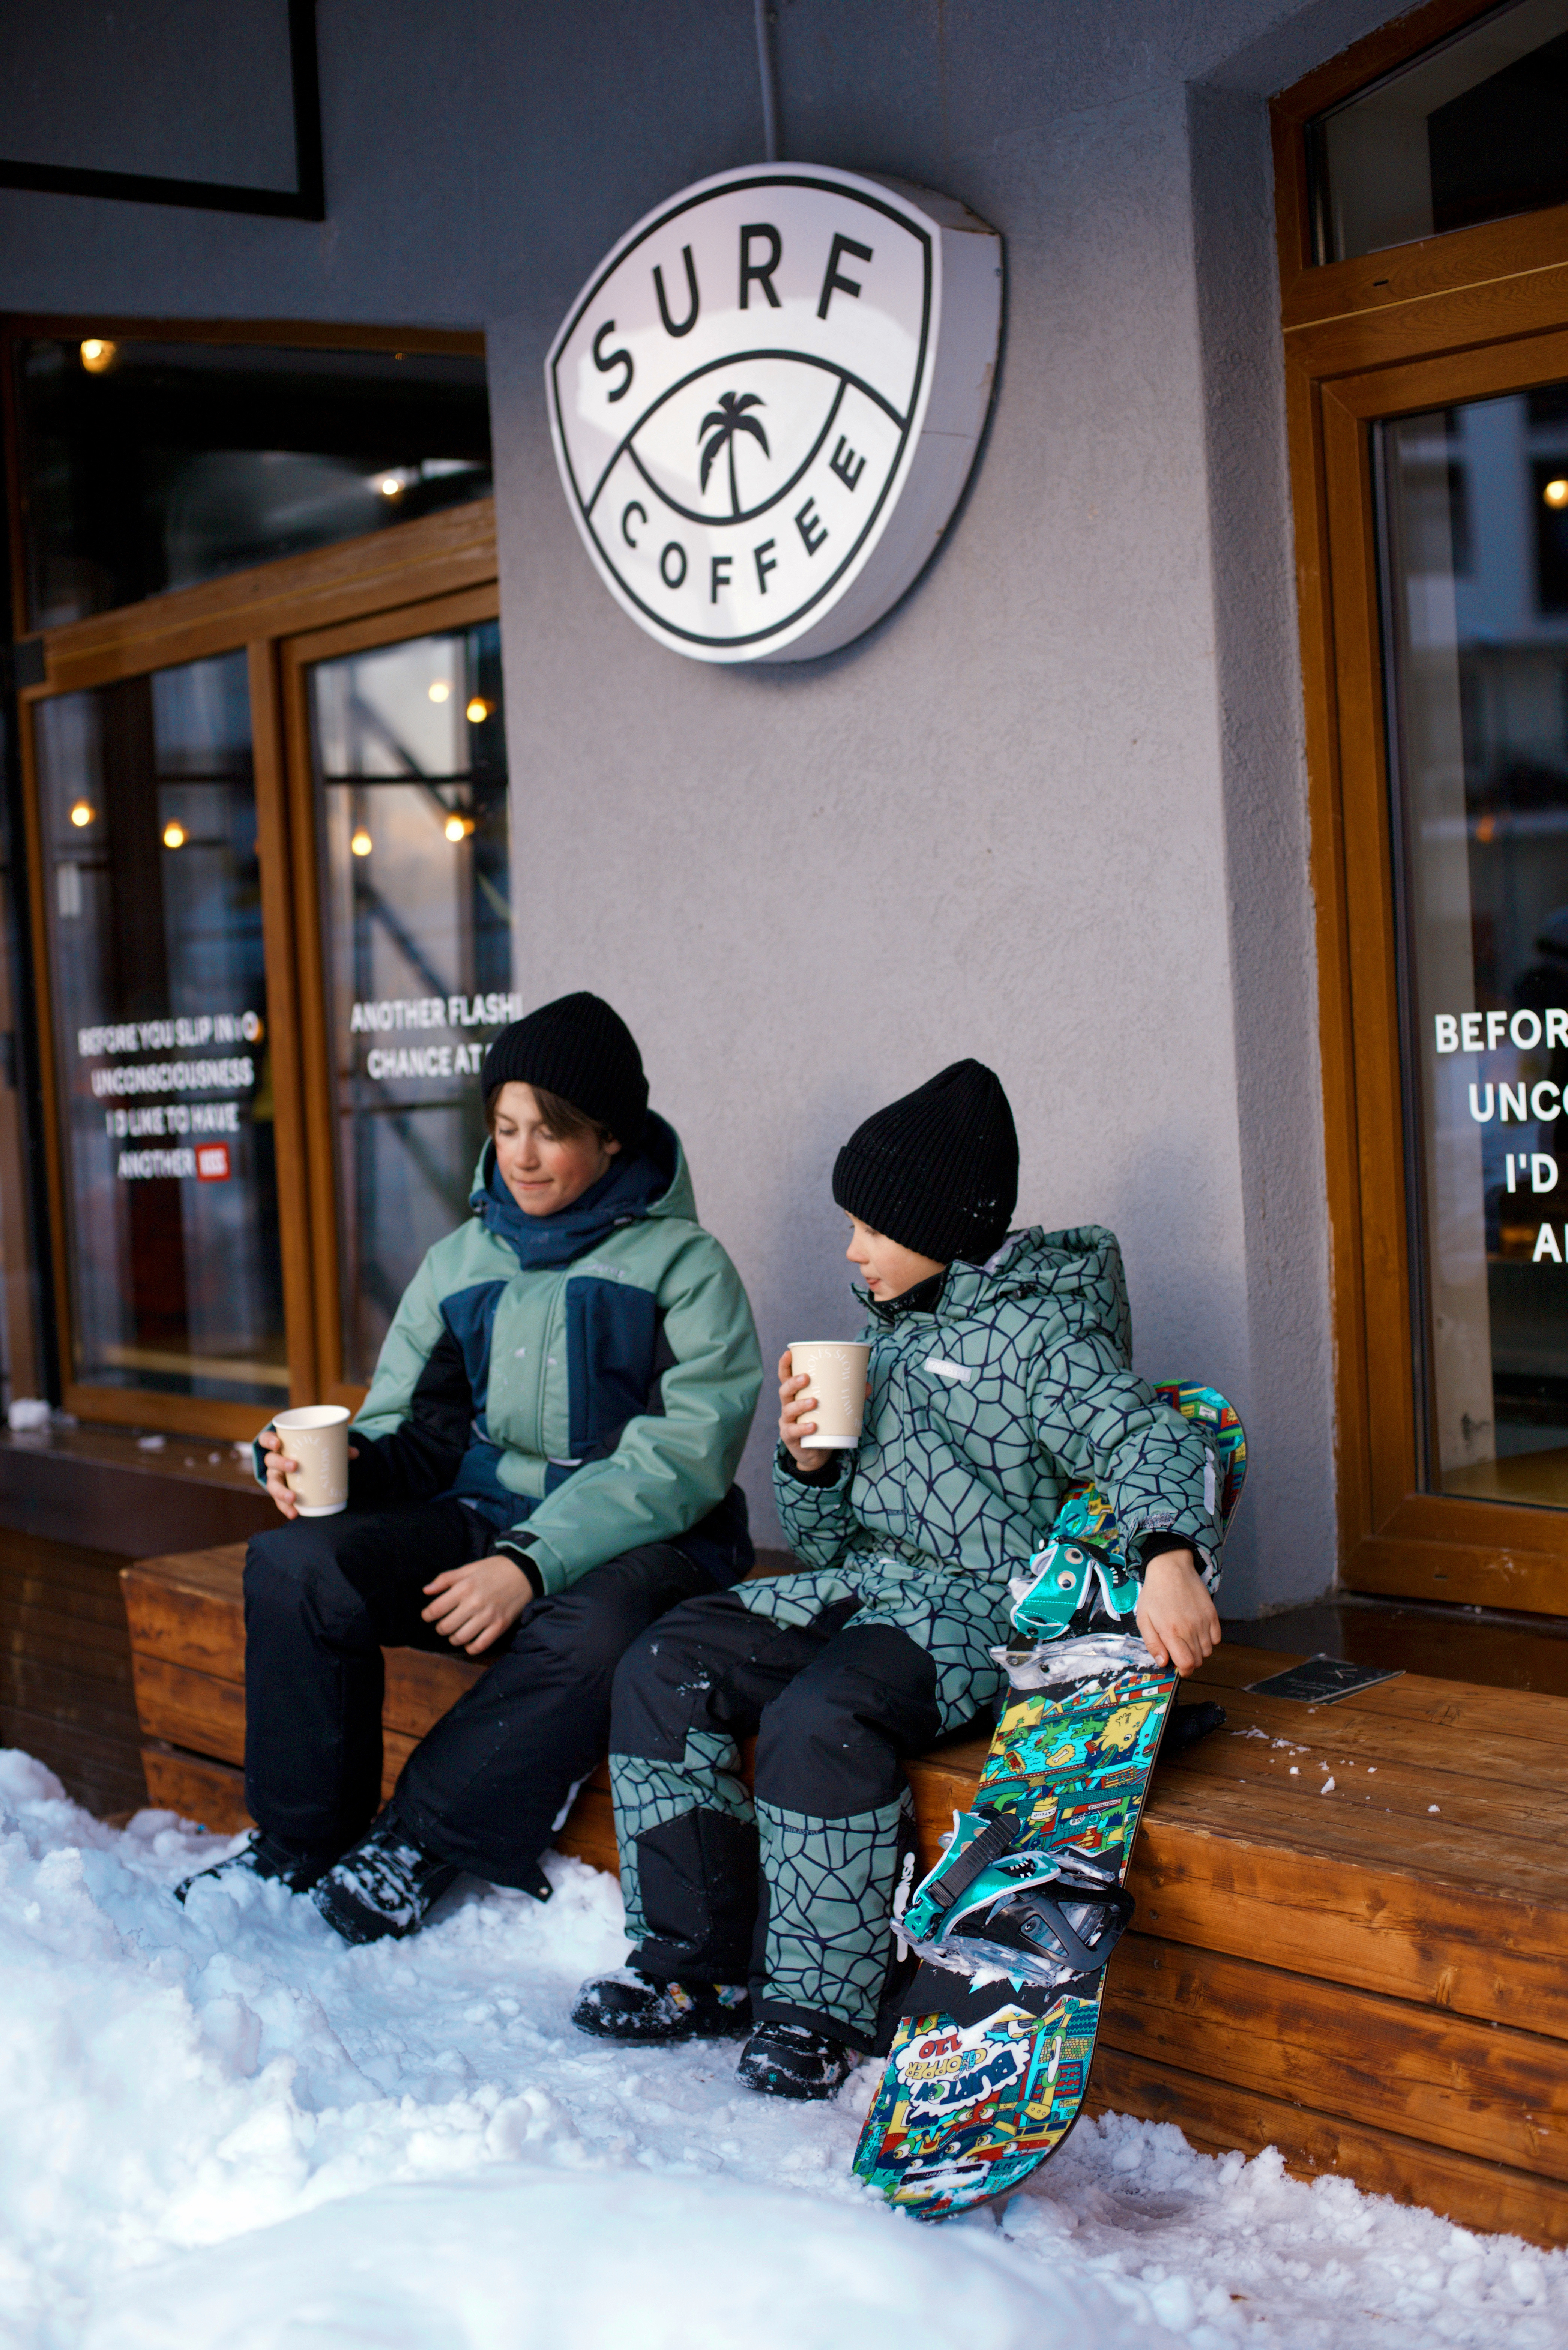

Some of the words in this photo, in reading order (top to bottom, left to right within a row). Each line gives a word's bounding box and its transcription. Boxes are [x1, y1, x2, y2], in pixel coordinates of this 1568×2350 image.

[592, 223, 874, 403] SURF
[622, 435, 867, 604] COFFEE
[138, 1019, 175, 1050] YOU
[175, 1015, 214, 1047] SLIP
[350, 997, 448, 1033] ANOTHER
[1434, 1008, 1568, 1053] BEFOR
[91, 1056, 254, 1098] UNCONSCIOUSNESS
[366, 1045, 453, 1080] CHANCE
[454, 1042, 482, 1074] AT
[165, 1104, 189, 1135] TO
[190, 1101, 240, 1134] HAVE
[1468, 1080, 1568, 1123] UNC
[1505, 1152, 1559, 1193] I'D
[1532, 1222, 1568, 1264] A
[1090, 1800, 1120, 1809] CONDIMENTS
[905, 2048, 988, 2080] CHOPPER
[919, 2033, 963, 2059] 110
[914, 2050, 1017, 2105] BURTON
